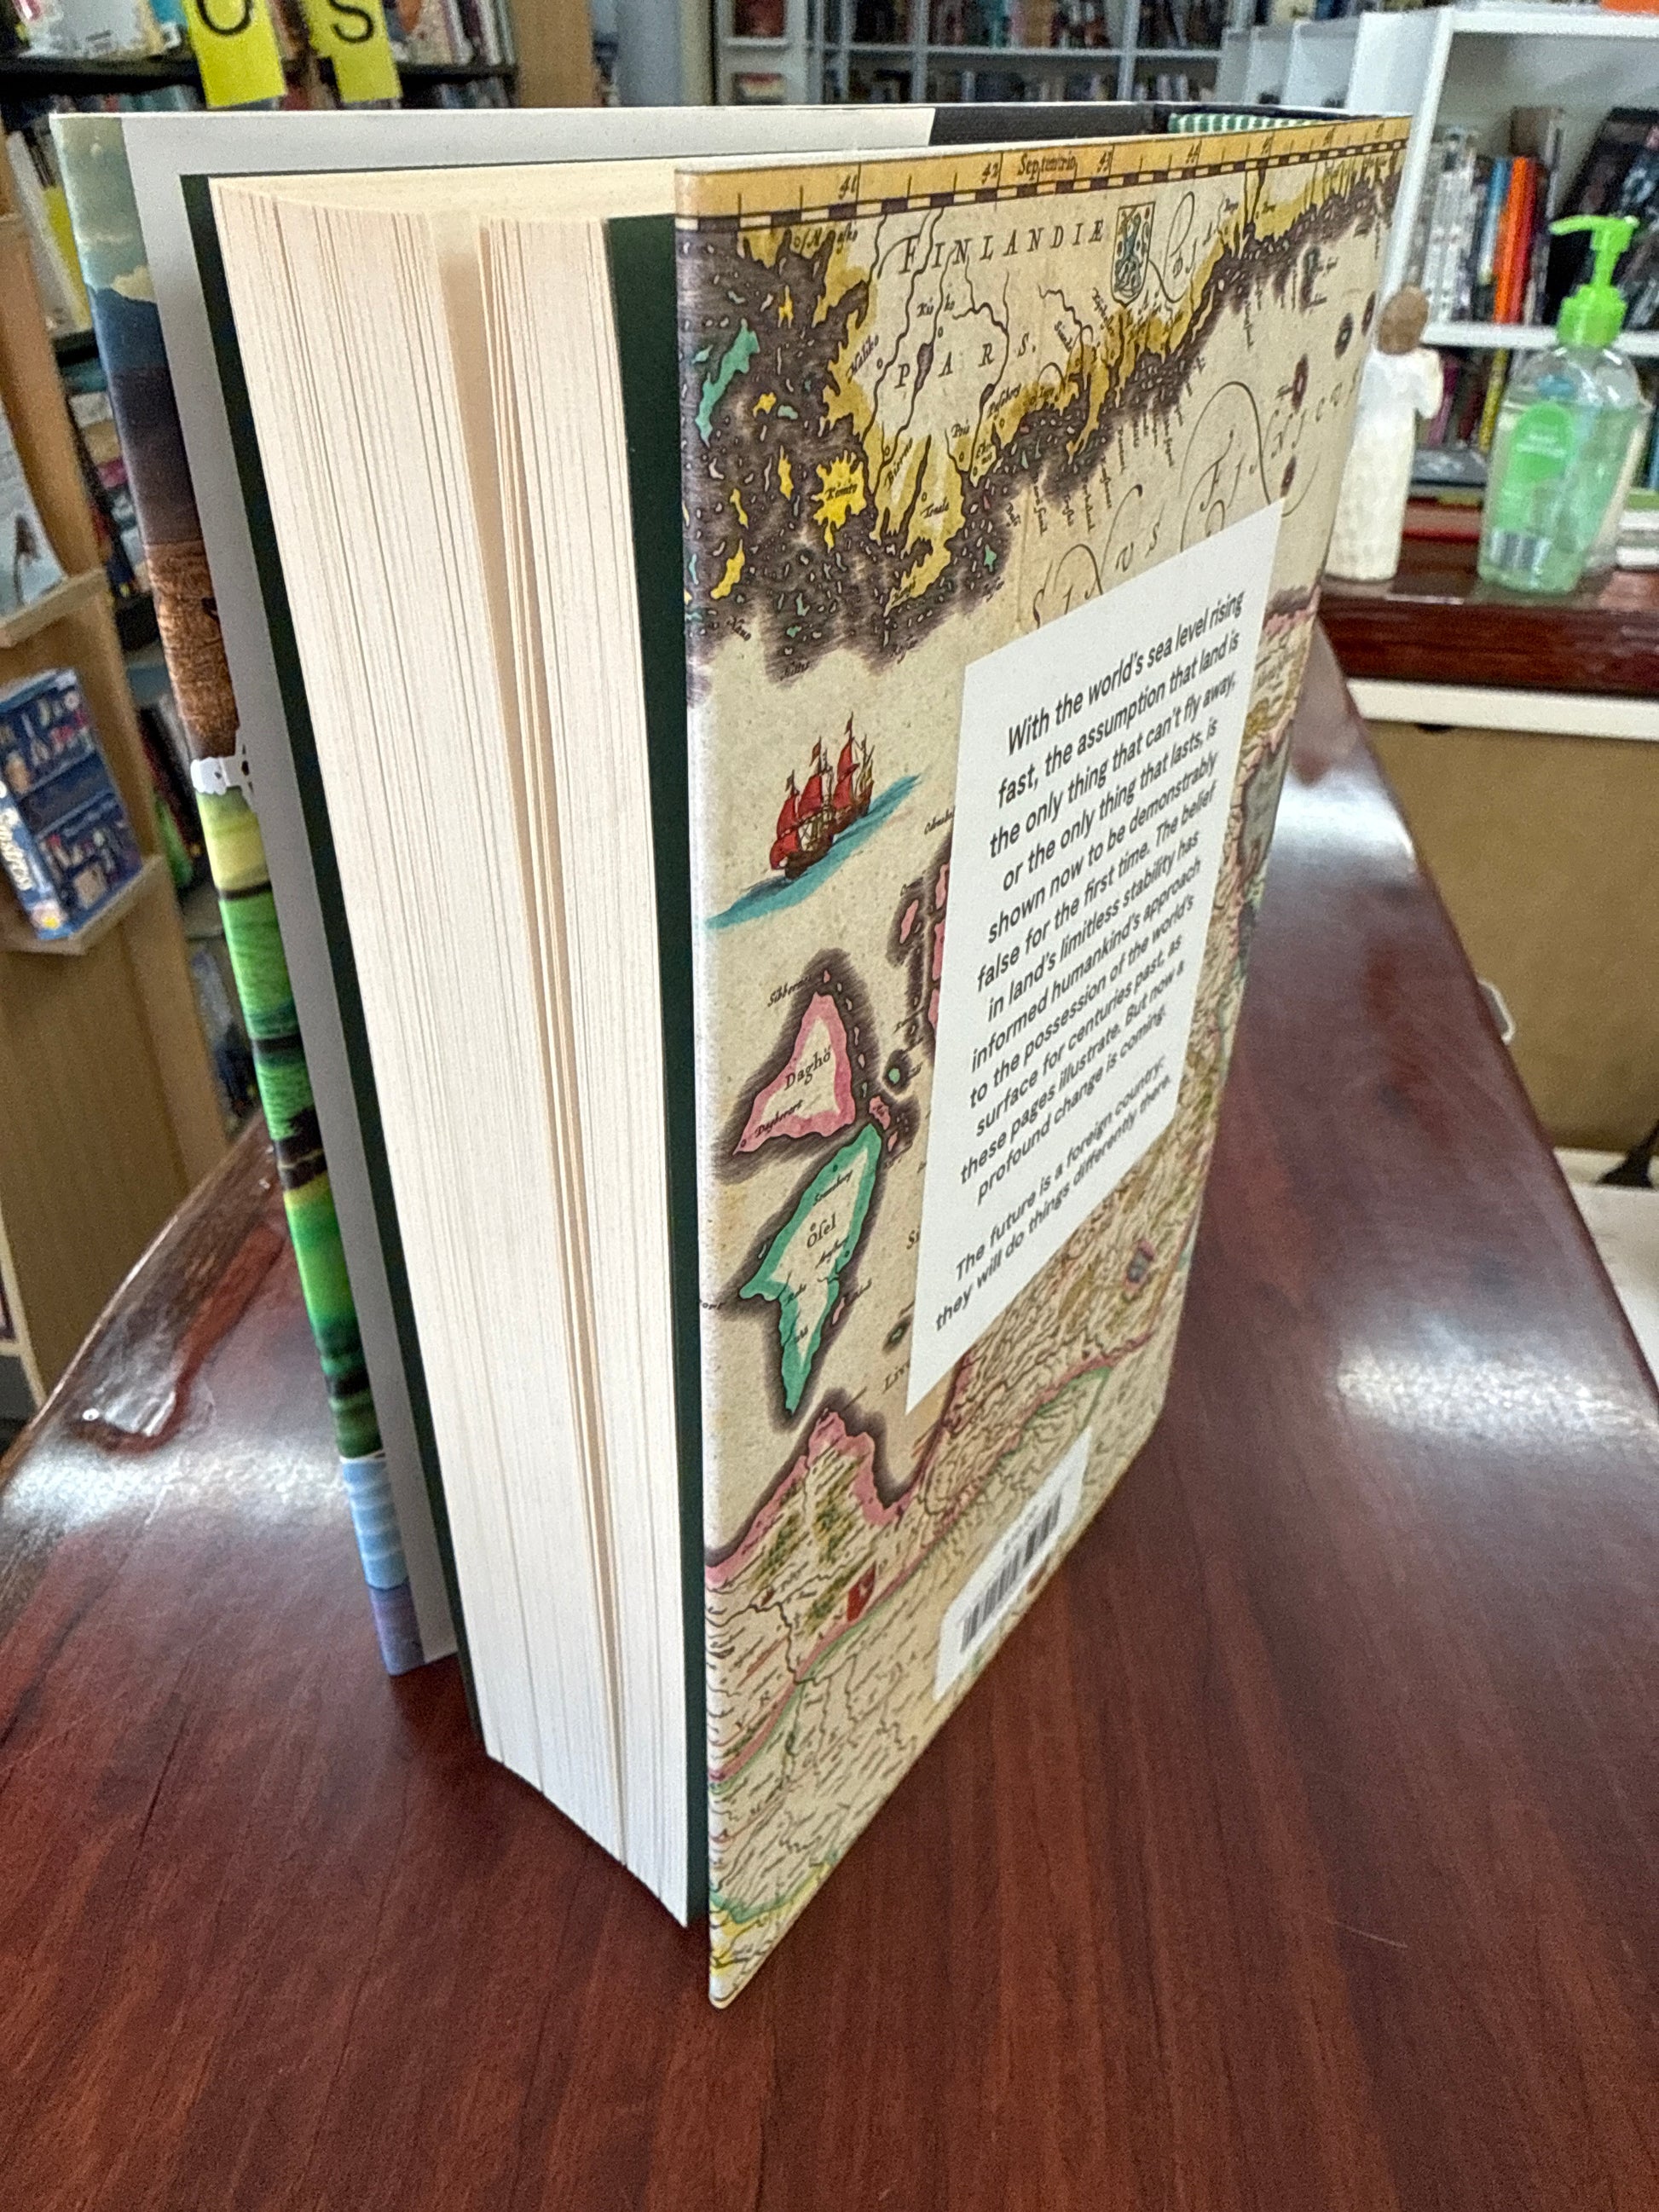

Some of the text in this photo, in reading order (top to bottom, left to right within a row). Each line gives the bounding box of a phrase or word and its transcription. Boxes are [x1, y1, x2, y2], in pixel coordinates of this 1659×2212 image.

[997, 630, 1240, 808] fast, the assumption that land is
[1008, 591, 1244, 755] With the world's sea level rising
[987, 752, 1218, 944] shown now to be demonstrably
[989, 822, 1020, 858] the
[1025, 790, 1064, 833] only
[1067, 759, 1109, 803] thing
[1112, 731, 1143, 771] that
[1145, 706, 1182, 748] can't
[1183, 694, 1201, 723] fly
[1003, 861, 1023, 891] or
[1027, 839, 1055, 873] the
[1060, 808, 1095, 849] only
[1099, 777, 1136, 820] thing
[1139, 752, 1169, 789] that
[1205, 716, 1217, 740] is
[971, 857, 1200, 1072] informed humankind's approach
[977, 779, 1217, 992] false for the first time. The belief
[987, 996, 1004, 1022] in
[1008, 951, 1056, 1005] land's
[1059, 898, 1120, 962] limitless
[1122, 850, 1176, 907] stability
[1176, 830, 1199, 860] has
[960, 1131, 1007, 1184] these
[1009, 1083, 1055, 1143] pages
[1124, 992, 1147, 1026] But
[1148, 968, 1175, 1002] now
[1176, 960, 1184, 975] a
[969, 894, 1194, 1108] to the possession of the world's
[975, 1069, 1038, 1136] surface
[1042, 1042, 1065, 1076] for
[1067, 981, 1132, 1050] centuries
[1167, 934, 1182, 957] as
[935, 1284, 973, 1331] they
[976, 1249, 1002, 1288] will
[1004, 1231, 1025, 1258] do
[1028, 1181, 1070, 1233] things
[1072, 1109, 1136, 1186] differently
[956, 1244, 986, 1280] The
[990, 1191, 1036, 1247] future
[1038, 1175, 1051, 1196] is
[1054, 1163, 1063, 1180] a
[1066, 1112, 1112, 1167] foreign
[977, 1112, 1051, 1205] profound
[1053, 1066, 1103, 1123] change
[1105, 1052, 1117, 1072] is
